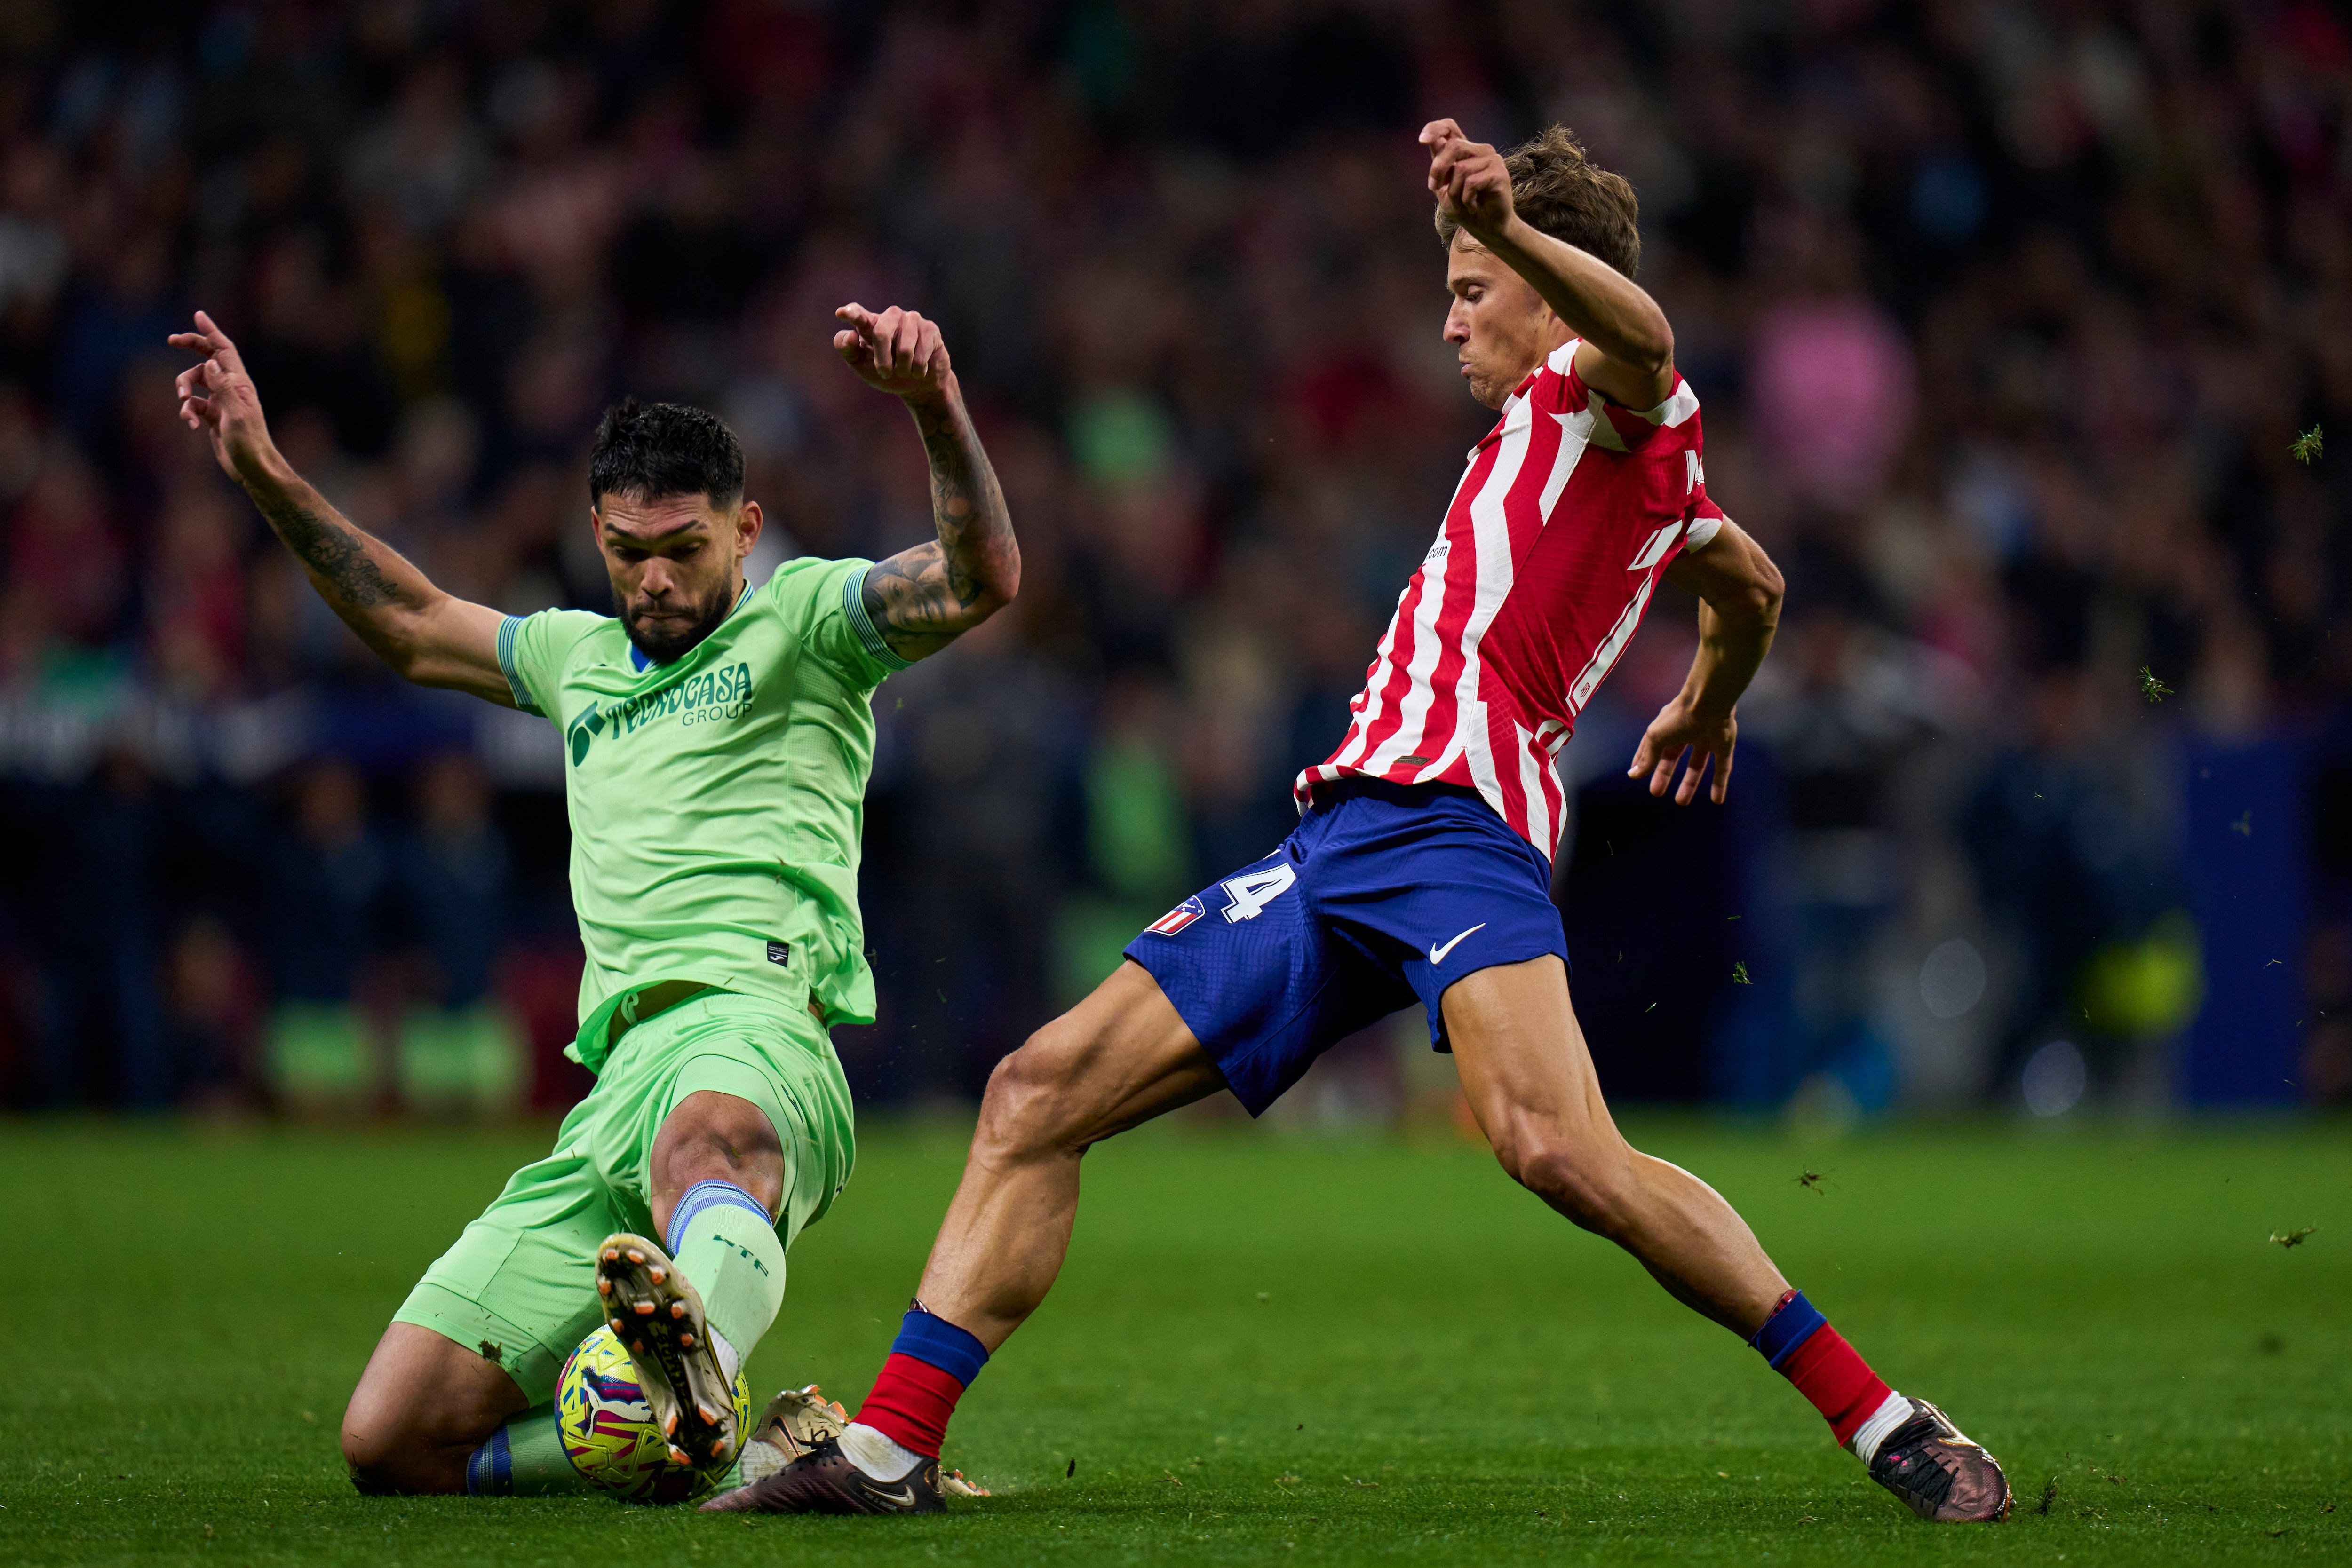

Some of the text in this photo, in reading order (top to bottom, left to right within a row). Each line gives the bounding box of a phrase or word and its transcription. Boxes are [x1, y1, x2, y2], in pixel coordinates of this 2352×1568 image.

[605, 662, 752, 740] TECNOCASA
[683, 704, 752, 726] GROUP
[1219, 849, 1296, 924] 4
